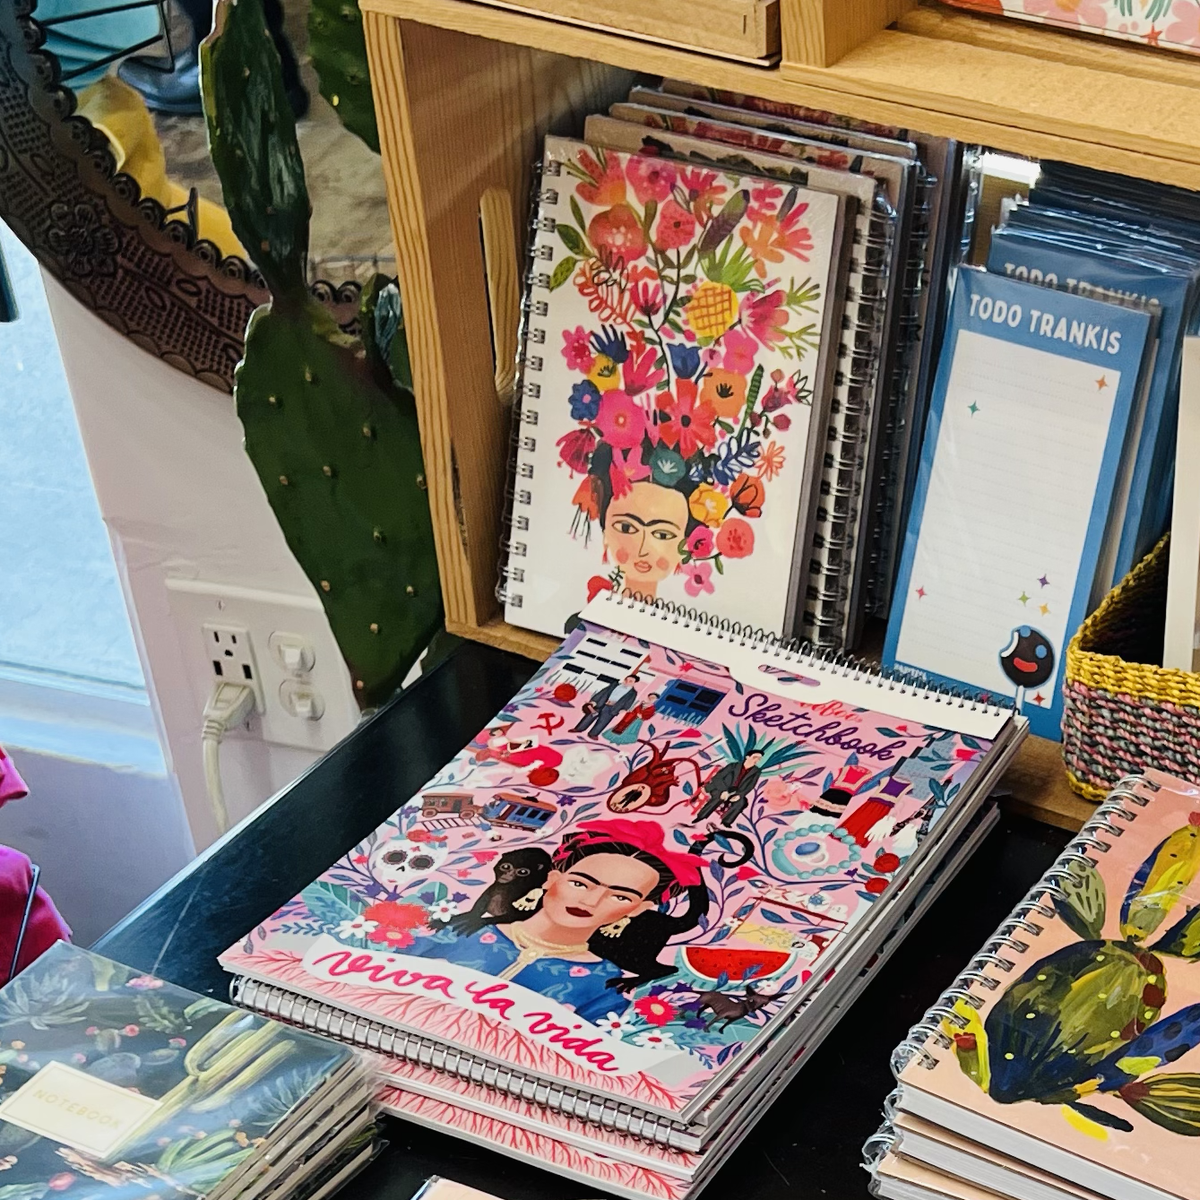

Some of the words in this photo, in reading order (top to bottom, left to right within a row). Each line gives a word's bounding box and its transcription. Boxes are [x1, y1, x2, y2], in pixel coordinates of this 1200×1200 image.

[970, 293, 1023, 328] TODO
[1030, 309, 1122, 355] TRANKIS
[728, 693, 907, 761] Sketchbook
[523, 1011, 619, 1072] vida
[32, 1088, 123, 1130] NOTEBOOK
